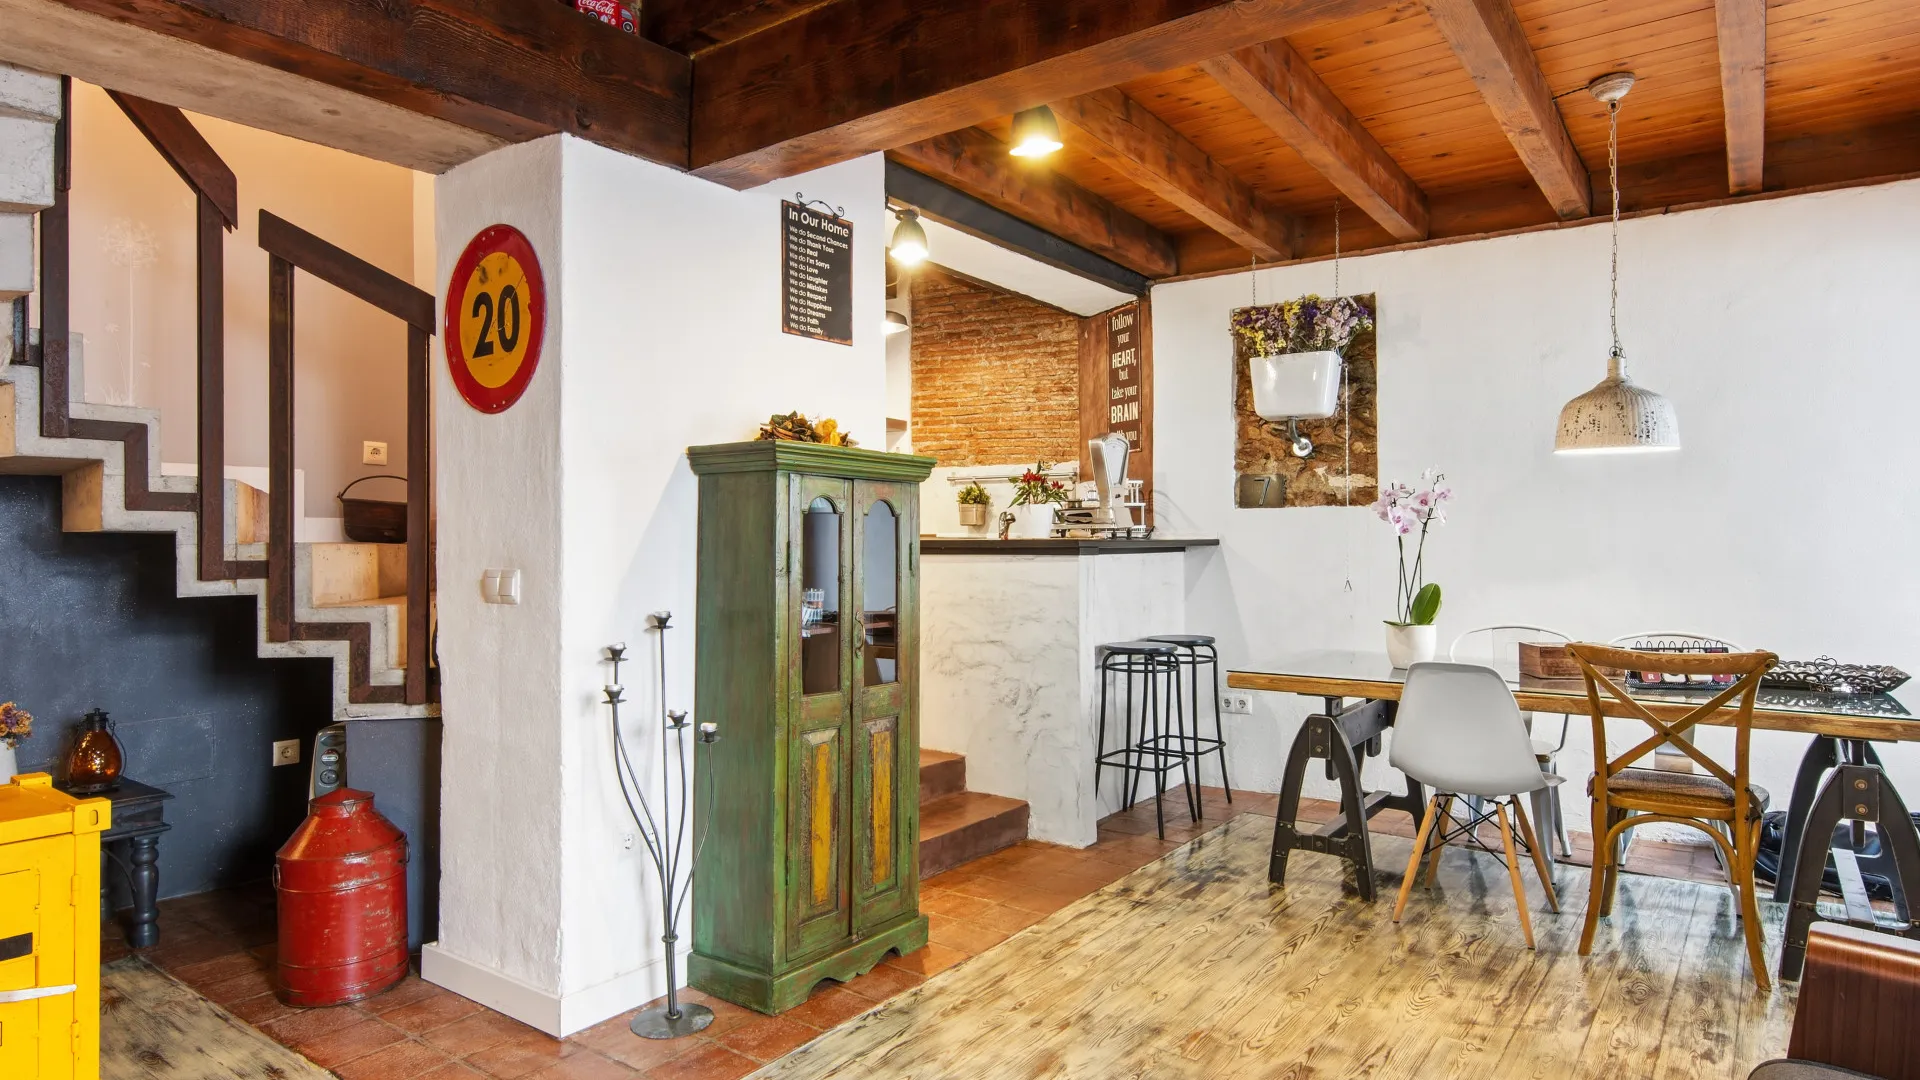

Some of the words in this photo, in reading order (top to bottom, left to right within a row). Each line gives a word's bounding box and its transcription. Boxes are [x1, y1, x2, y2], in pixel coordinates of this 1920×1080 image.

[789, 208, 798, 221] In
[801, 212, 819, 228] Our
[821, 218, 849, 237] Home
[807, 231, 826, 242] Second
[826, 238, 848, 249] Chances
[807, 240, 822, 250] Thank
[822, 244, 834, 254] Yous
[807, 248, 818, 257] Real
[790, 260, 798, 268] We
[807, 266, 818, 274] Love
[815, 260, 830, 270] Sorrys
[807, 274, 828, 285] Laughter
[807, 283, 828, 294] Mistakes
[807, 292, 827, 302] Respect
[807, 300, 832, 312] Happiness
[807, 308, 826, 318] Dreams
[472, 284, 520, 359] 20
[807, 317, 820, 325] Faith
[807, 326, 824, 335] Family
[1117, 332, 1130, 347] your
[1112, 348, 1136, 368] HEART,
[1119, 368, 1128, 380] but
[1112, 386, 1124, 399] take
[1124, 385, 1138, 400] your
[1111, 402, 1138, 424] BRAIN
[1254, 476, 1271, 506] 7
